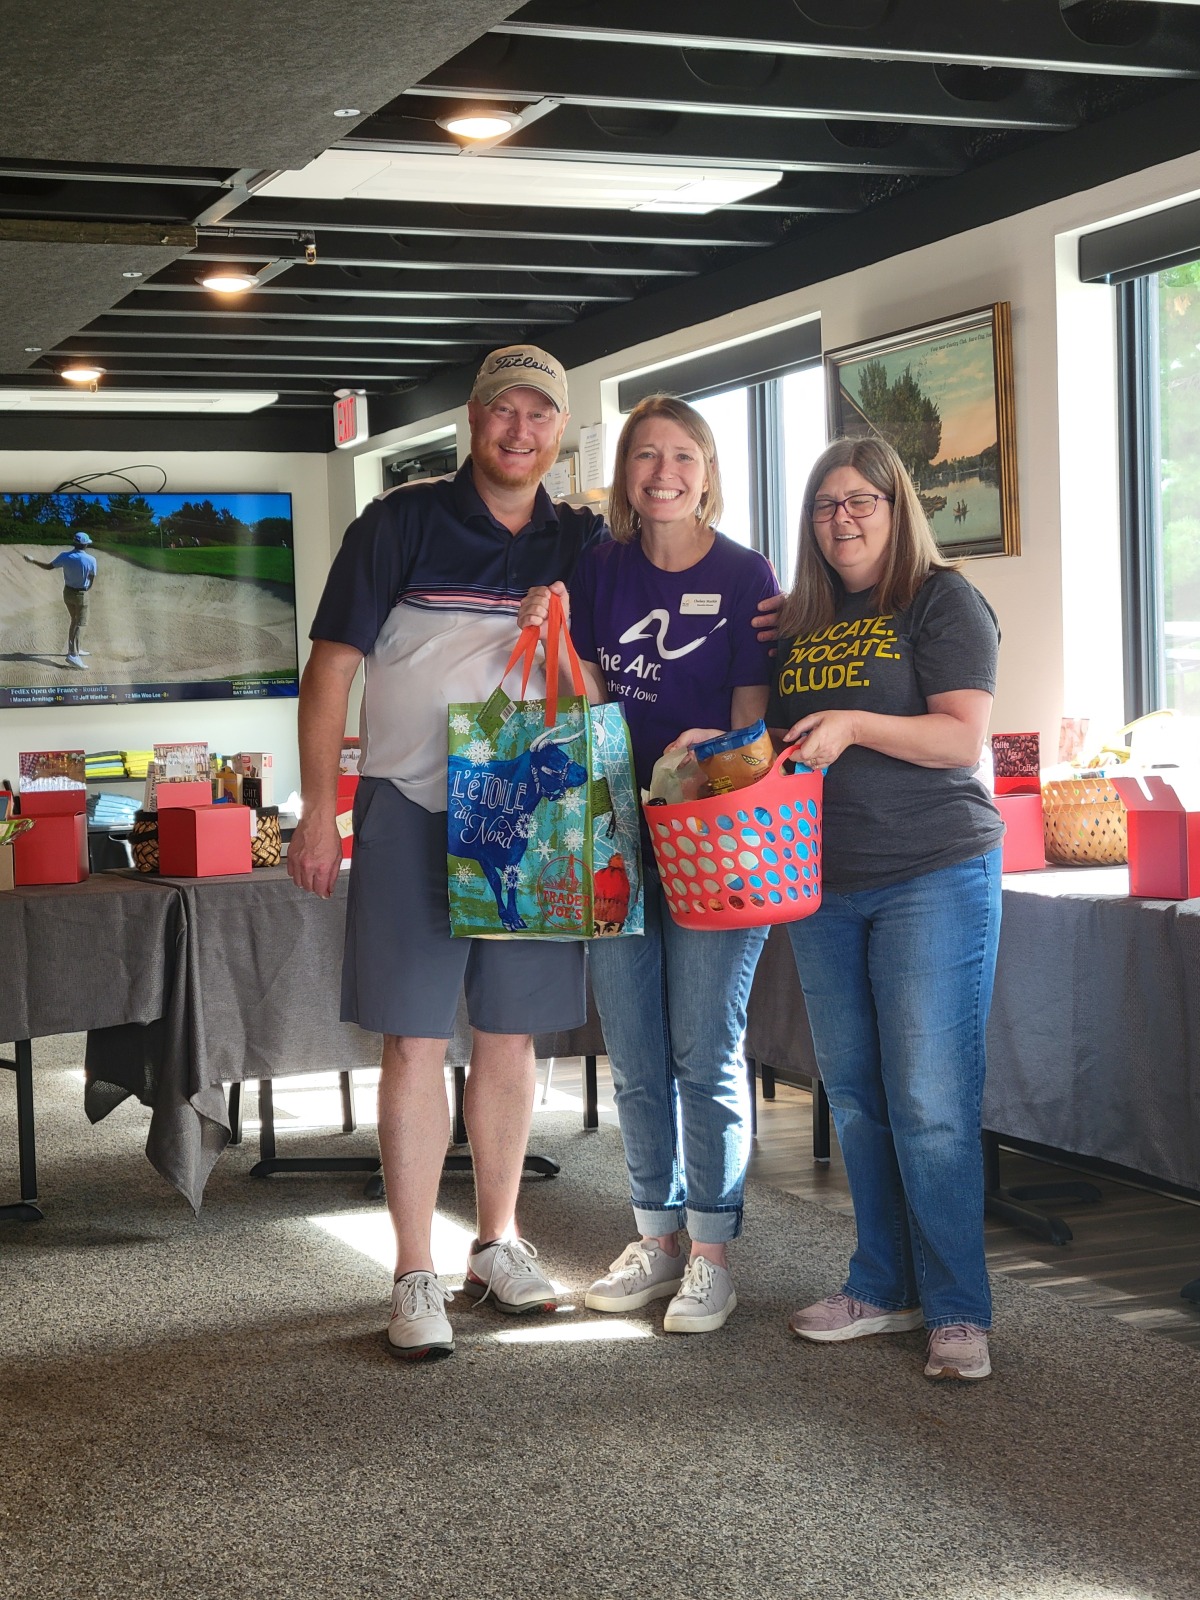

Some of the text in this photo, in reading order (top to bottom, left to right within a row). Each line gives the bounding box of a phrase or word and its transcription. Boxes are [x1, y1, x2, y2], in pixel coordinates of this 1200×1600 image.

[489, 353, 557, 379] Titleist
[336, 396, 355, 442] EXIT
[632, 686, 658, 703] Iowa
[451, 798, 472, 827] du
[543, 889, 591, 908] TRADER
[547, 904, 583, 921] JOE'S
